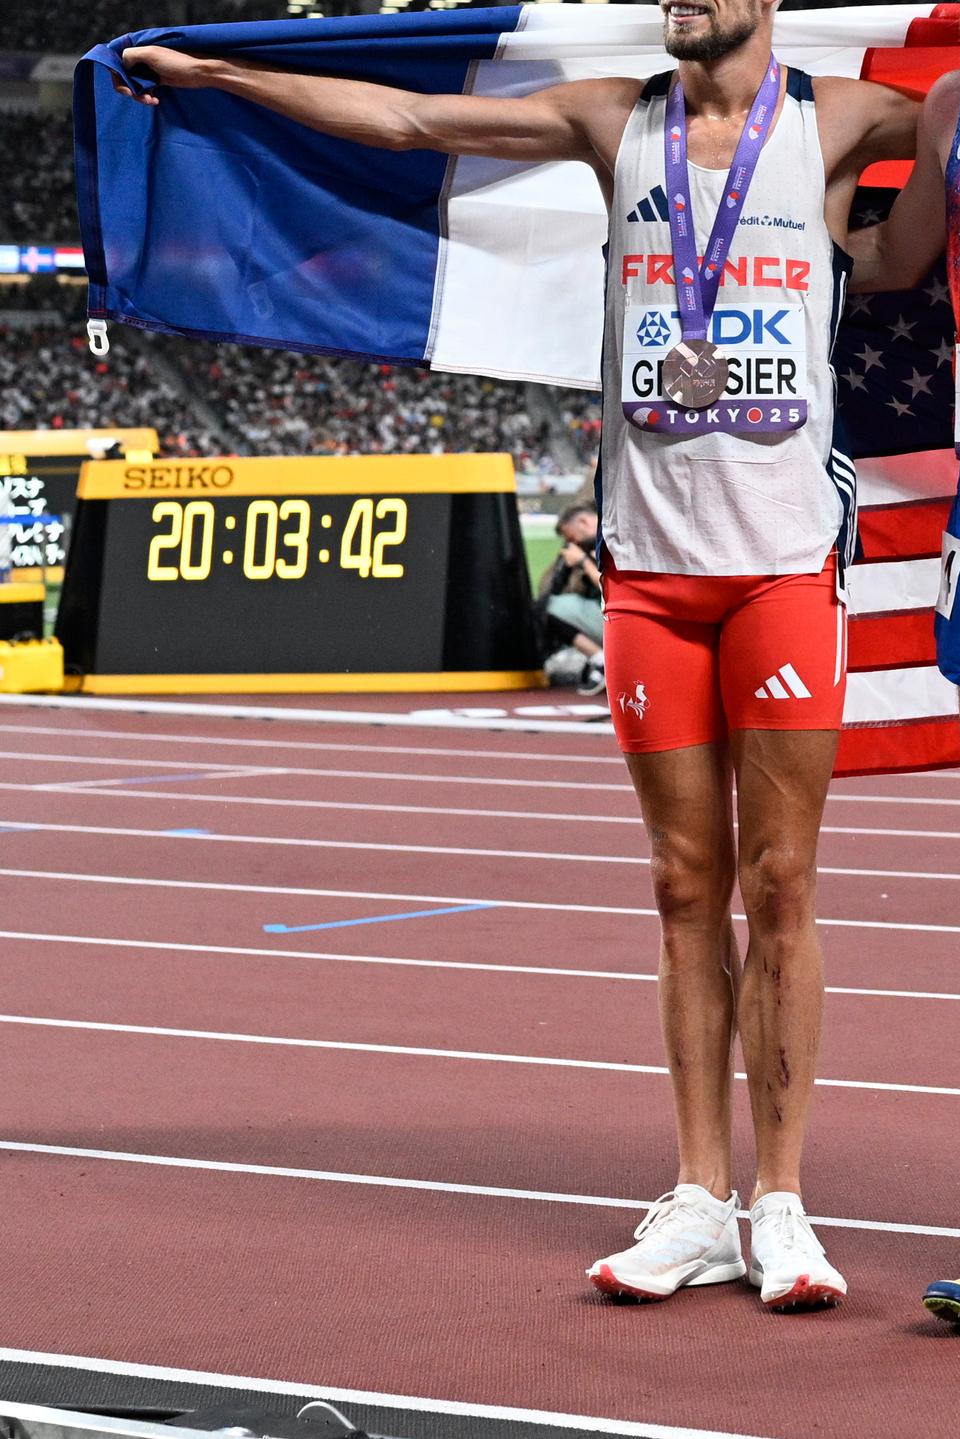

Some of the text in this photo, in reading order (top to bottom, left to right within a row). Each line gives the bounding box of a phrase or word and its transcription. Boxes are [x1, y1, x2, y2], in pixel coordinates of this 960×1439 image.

[773, 217, 806, 231] Mutuel
[622, 254, 811, 291] FRNCE
[671, 309, 792, 345] DK
[632, 357, 797, 398] GSIER
[123, 466, 235, 490] SEIKO
[147, 498, 408, 581] 20:03:42
